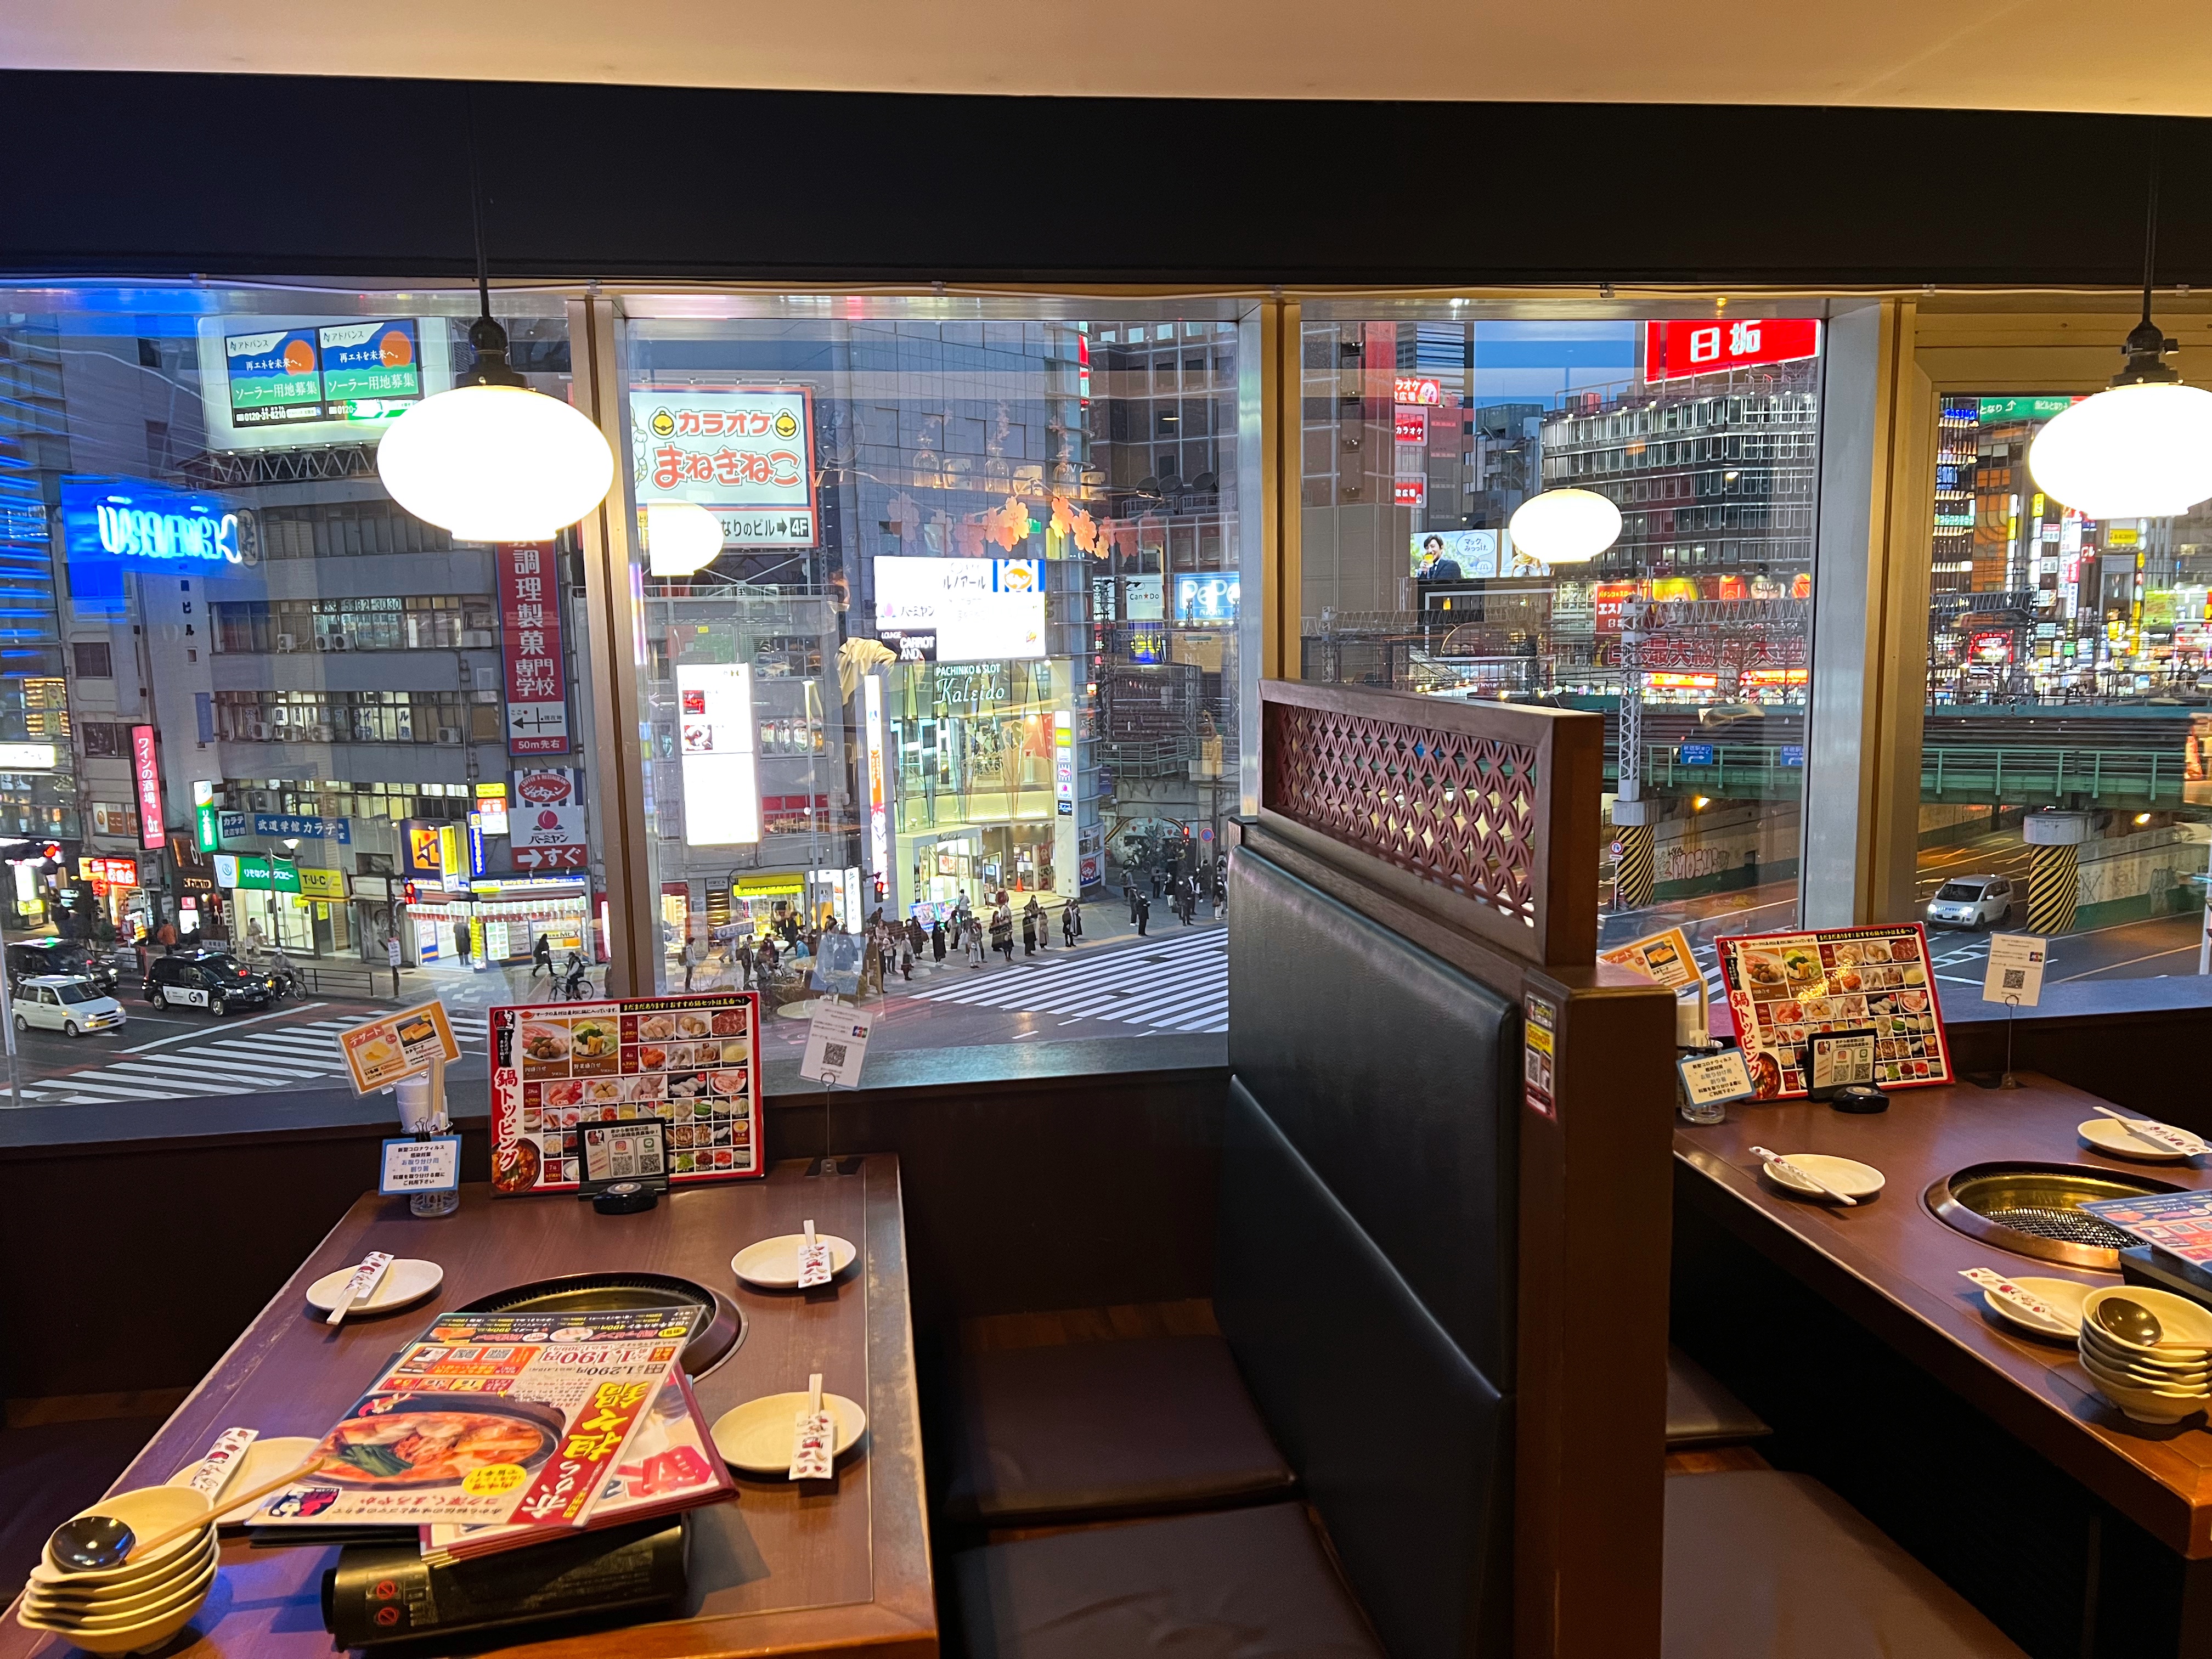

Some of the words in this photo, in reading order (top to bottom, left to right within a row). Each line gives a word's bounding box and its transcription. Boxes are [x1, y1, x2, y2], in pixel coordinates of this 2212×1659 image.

[332, 331, 364, 341] アドバンス
[238, 340, 268, 349] アドバンス
[340, 350, 398, 363] 再エネを未来へ。
[245, 359, 302, 371] 再エネを未来へ。
[329, 373, 415, 392] ソーラー用地募集
[1395, 380, 1420, 391] ラオケ
[236, 381, 317, 400] ソーラー用地募集
[679, 412, 771, 436] カラオケ
[1396, 426, 1423, 435] カラオケ
[654, 444, 801, 487] まねきねこ
[721, 520, 775, 539] なりのビル
[792, 521, 808, 537] 4F
[900, 606, 935, 617] バーミヤン
[900, 636, 935, 648] CARROT
[1131, 634, 1161, 654] GU
[936, 665, 975, 676] PACHINKO
[981, 663, 1001, 674] SLOT
[932, 675, 1005, 706] Kaleido
[518, 739, 561, 751] 50m先右
[138, 738, 156, 809] ワインの酒場。
[521, 775, 537, 787] COFFEE
[541, 774, 568, 786] RESTAURANT
[223, 816, 244, 826] カラテ
[258, 819, 300, 832] 武道学館
[303, 821, 336, 836] カラテ
[528, 834, 569, 844] バーミヤン
[544, 847, 580, 866] すぐ
[244, 868, 294, 880] りそなクイクロビー
[189, 991, 203, 1003] GO
[350, 1027, 381, 1046] デザート
[1732, 990, 1761, 1081] 鍋トッピング
[495, 1068, 518, 1171] 鍋トッピング
